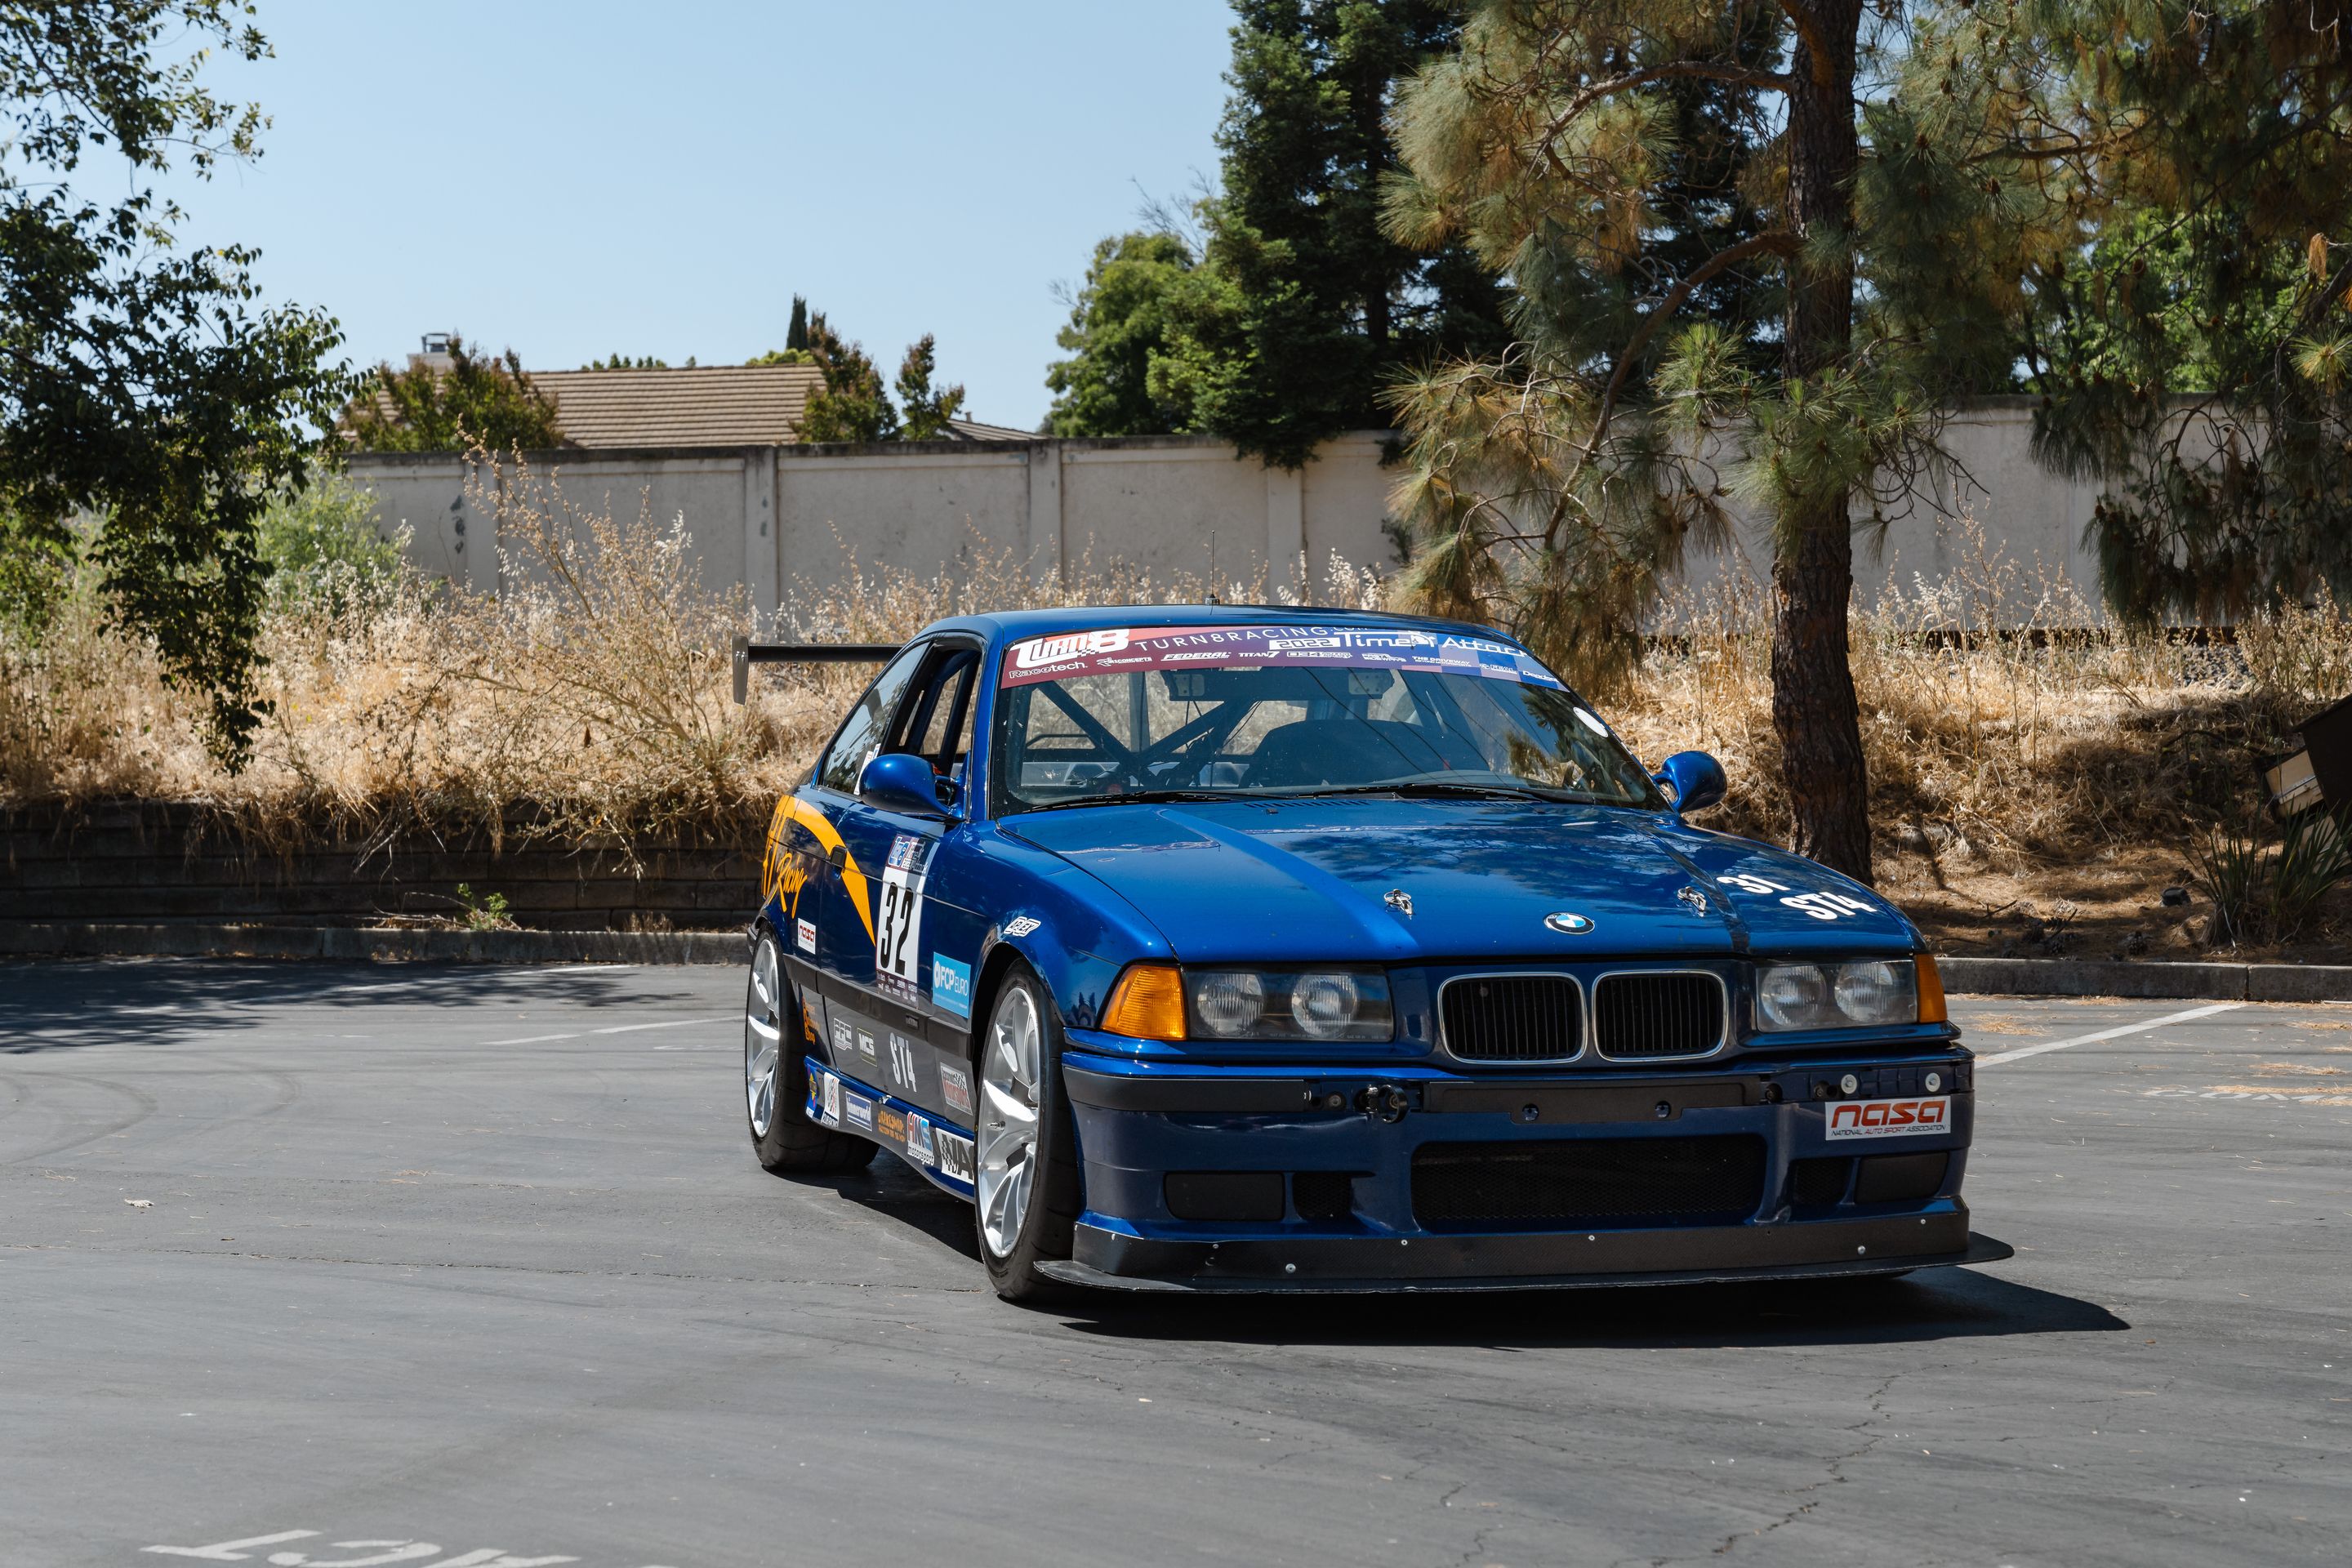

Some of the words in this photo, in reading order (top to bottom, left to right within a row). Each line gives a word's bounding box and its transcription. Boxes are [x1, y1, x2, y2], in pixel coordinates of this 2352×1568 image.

[1135, 626, 1369, 652] TURN8RACING.
[1276, 639, 1334, 649] 2022
[1162, 651, 1232, 661] FEDERAL
[1429, 657, 1471, 665] DRIVEWAY
[1780, 891, 1878, 920] ST4
[880, 881, 914, 976] 32
[940, 966, 956, 991] FCP
[955, 976, 969, 997] EURO
[858, 1032, 875, 1057] MCS
[889, 1031, 917, 1093] ST4
[1830, 1100, 1947, 1129] nasa
[907, 1111, 933, 1153] HMS
[1883, 1126, 1906, 1134] SPORT
[1905, 1125, 1946, 1133] ASSOCIATION
[907, 1146, 935, 1166] motorsport
[939, 1133, 974, 1181] VA
